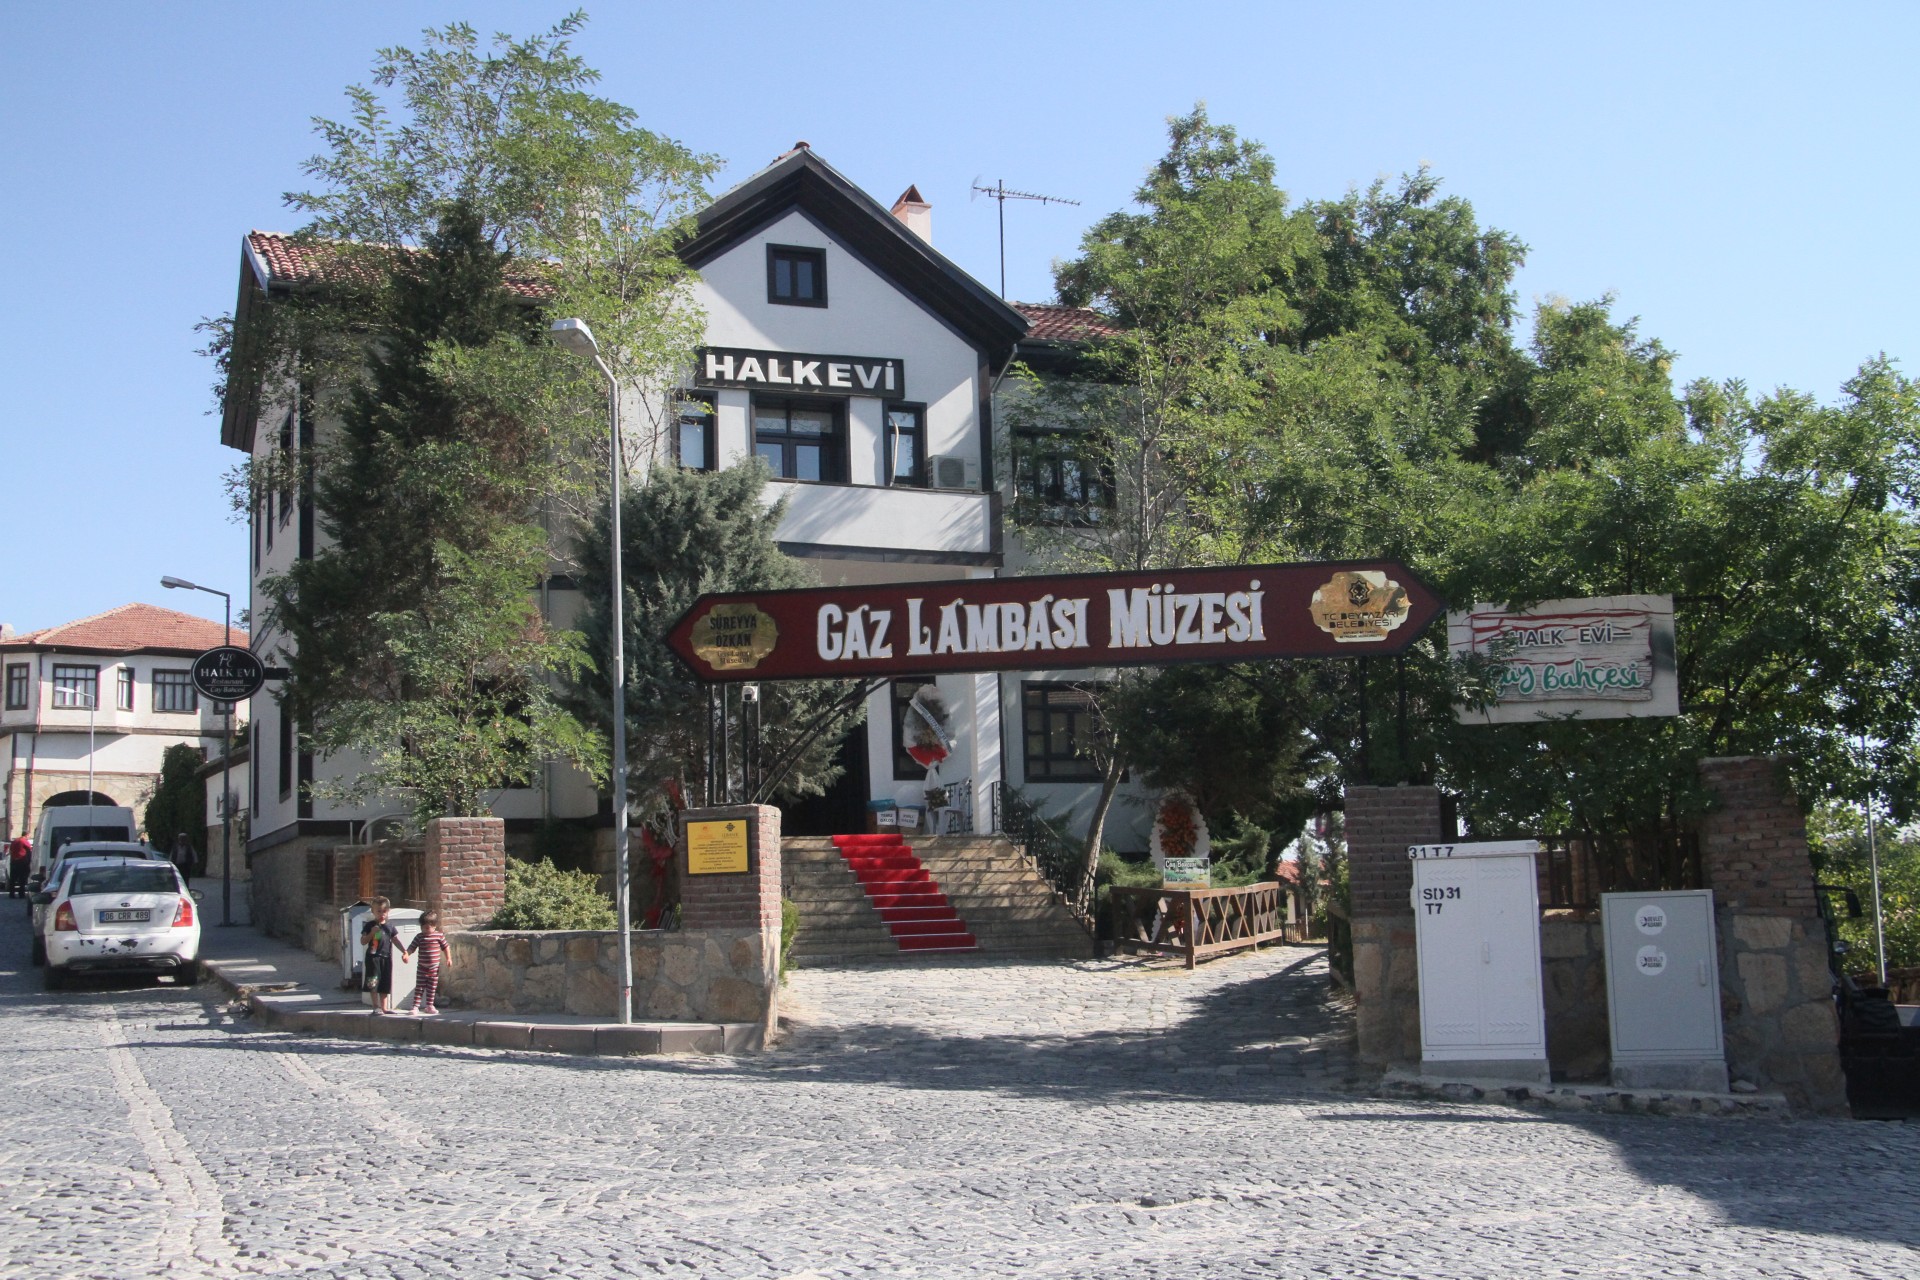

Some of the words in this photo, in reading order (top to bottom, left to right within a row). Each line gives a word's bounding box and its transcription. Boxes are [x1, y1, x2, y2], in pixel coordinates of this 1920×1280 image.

[706, 354, 895, 390] HALKEVİ
[710, 613, 757, 630] SÜREYYA
[817, 603, 893, 661] GAZ
[906, 594, 1090, 656] LAMBASI
[1107, 579, 1266, 648] MÜZESİ
[1341, 610, 1399, 620] BEYPAZARI
[1329, 619, 1392, 629] BELEDİYESİ
[715, 631, 752, 648] ÖZKAN
[1580, 623, 1611, 643] EVİ
[200, 668, 233, 677] HALK
[1542, 659, 1644, 692] Bahçesi
[1409, 846, 1426, 859] 31
[105, 912, 114, 920] 06
[135, 911, 149, 919] 489
[1425, 903, 1442, 915] T7
